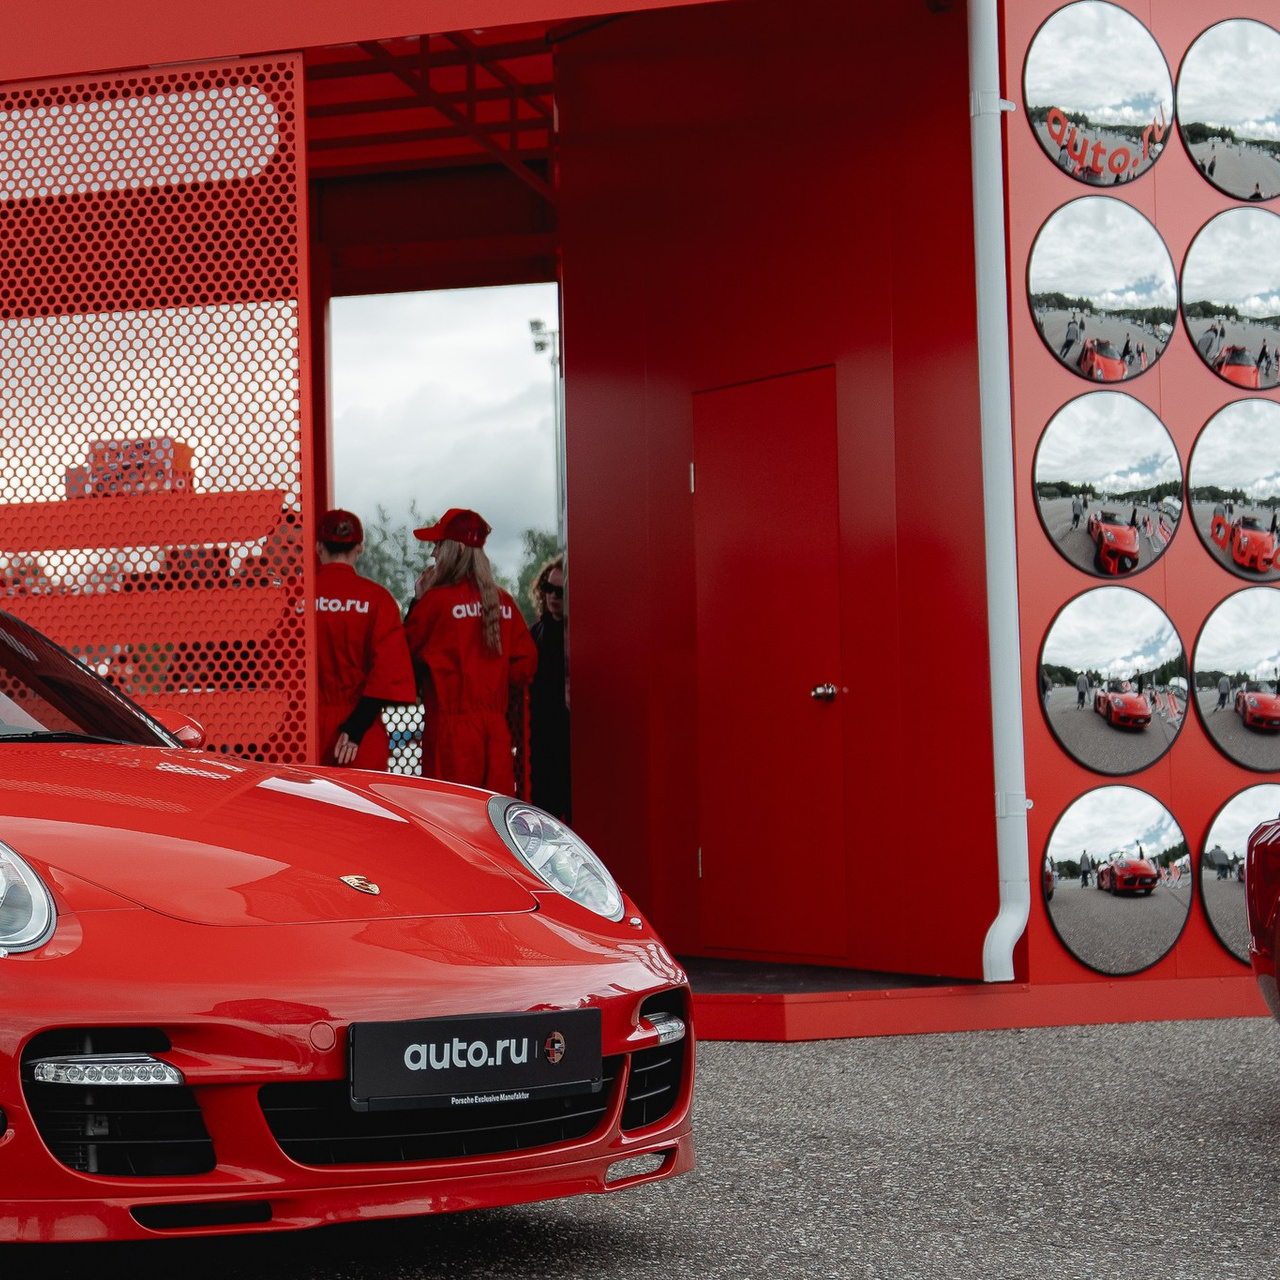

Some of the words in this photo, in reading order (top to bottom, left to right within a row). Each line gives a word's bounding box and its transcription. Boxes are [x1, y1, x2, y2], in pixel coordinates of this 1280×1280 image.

[1047, 100, 1167, 174] auto.ru
[404, 1038, 528, 1071] auto.ru
[451, 1096, 474, 1105] Porsche
[474, 1094, 499, 1104] Exclusive
[500, 1091, 530, 1101] Manufaktur
